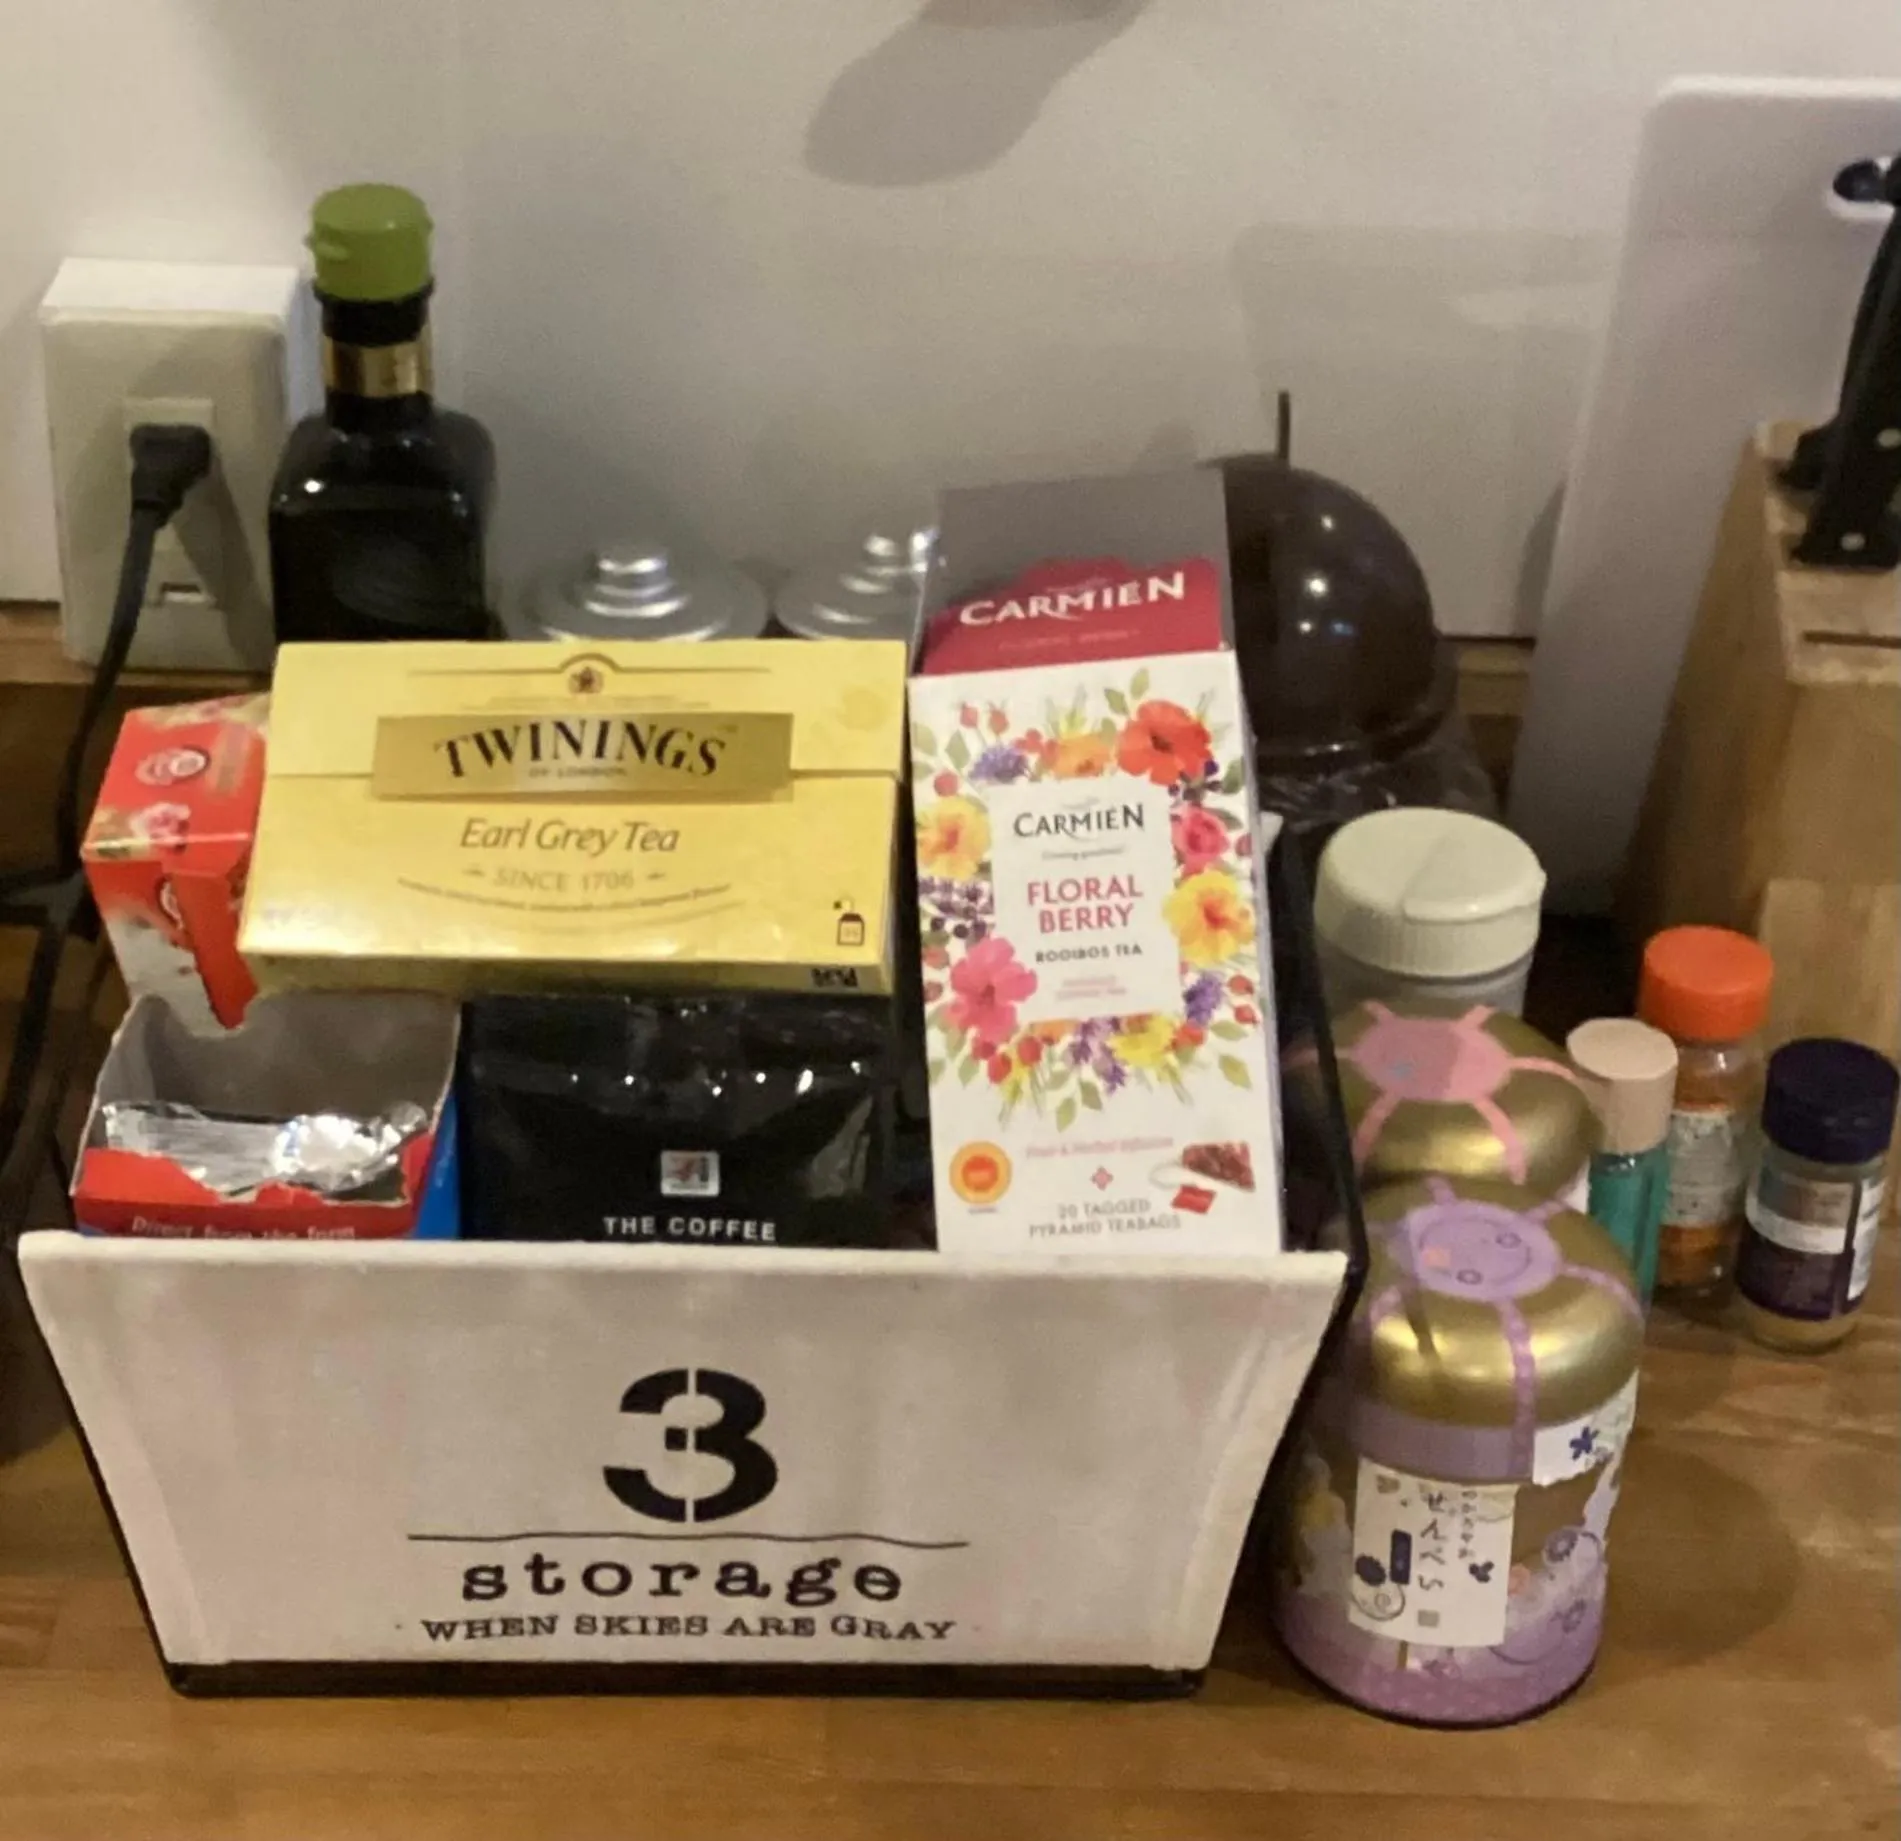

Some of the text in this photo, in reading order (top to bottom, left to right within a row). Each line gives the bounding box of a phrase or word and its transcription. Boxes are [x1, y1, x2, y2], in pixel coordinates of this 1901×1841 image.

[434, 719, 726, 778] TWININGS
[460, 817, 681, 858] Earl Grey Tea
[493, 868, 570, 892] SINCE
[1027, 874, 1143, 906] FLORAL
[1039, 902, 1134, 934] BERRY
[1035, 943, 1142, 964] ROOIBOS TEA
[1084, 1197, 1151, 1216] TAGGED
[603, 1217, 776, 1241] THE COFFEE
[603, 1368, 778, 1522] 3
[462, 1553, 902, 1607] storage
[422, 1615, 956, 1642] WHEN SKIES ARE GRAY
